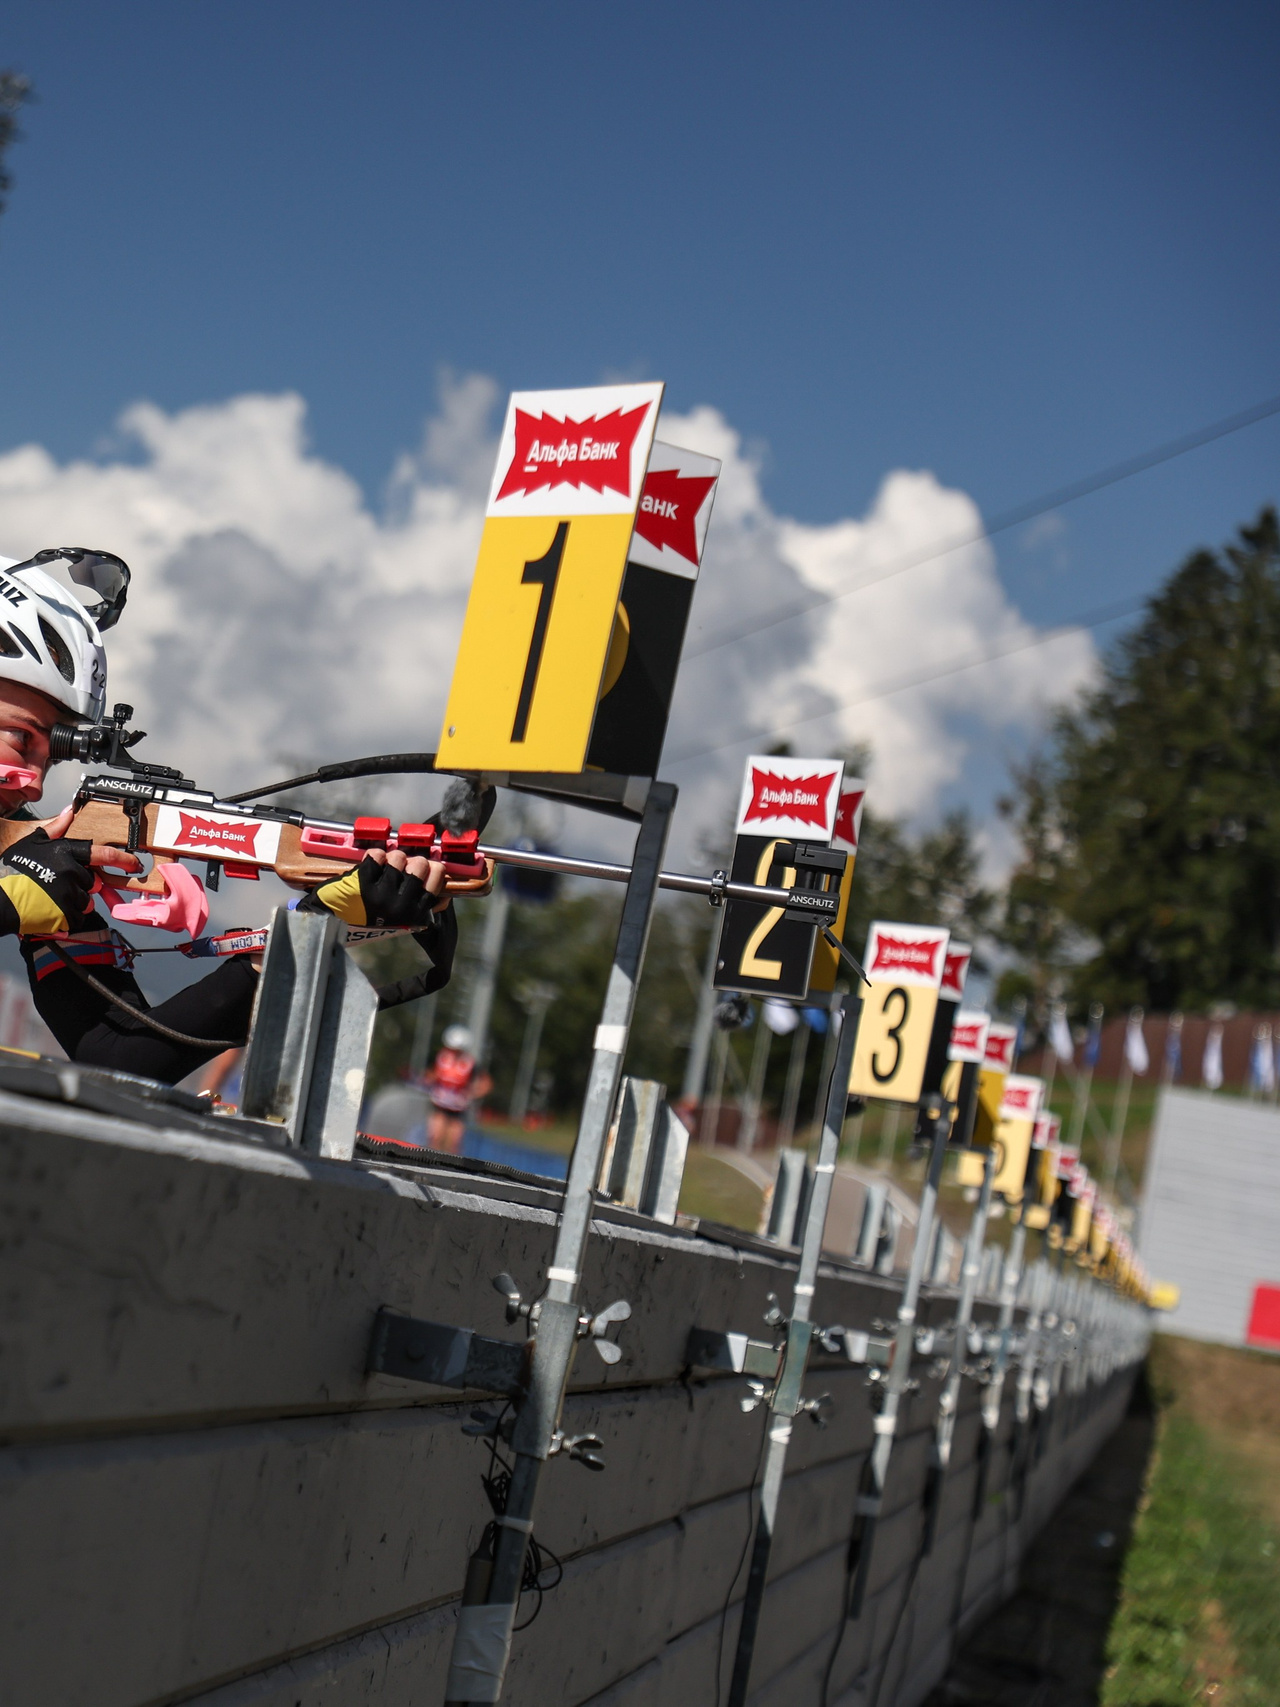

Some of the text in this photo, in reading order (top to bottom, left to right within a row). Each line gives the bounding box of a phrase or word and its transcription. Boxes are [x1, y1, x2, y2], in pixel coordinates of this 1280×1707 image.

[524, 437, 620, 471] Альфа Банк
[640, 494, 680, 520] анк
[510, 521, 571, 743] 1
[96, 779, 153, 795] ANSCHUTZ
[759, 786, 819, 807] Альфа Банк
[189, 825, 246, 842] Альфа Банк
[738, 838, 797, 981] 2
[790, 895, 834, 909] ANSCHUTZ
[871, 987, 909, 1083] 3
